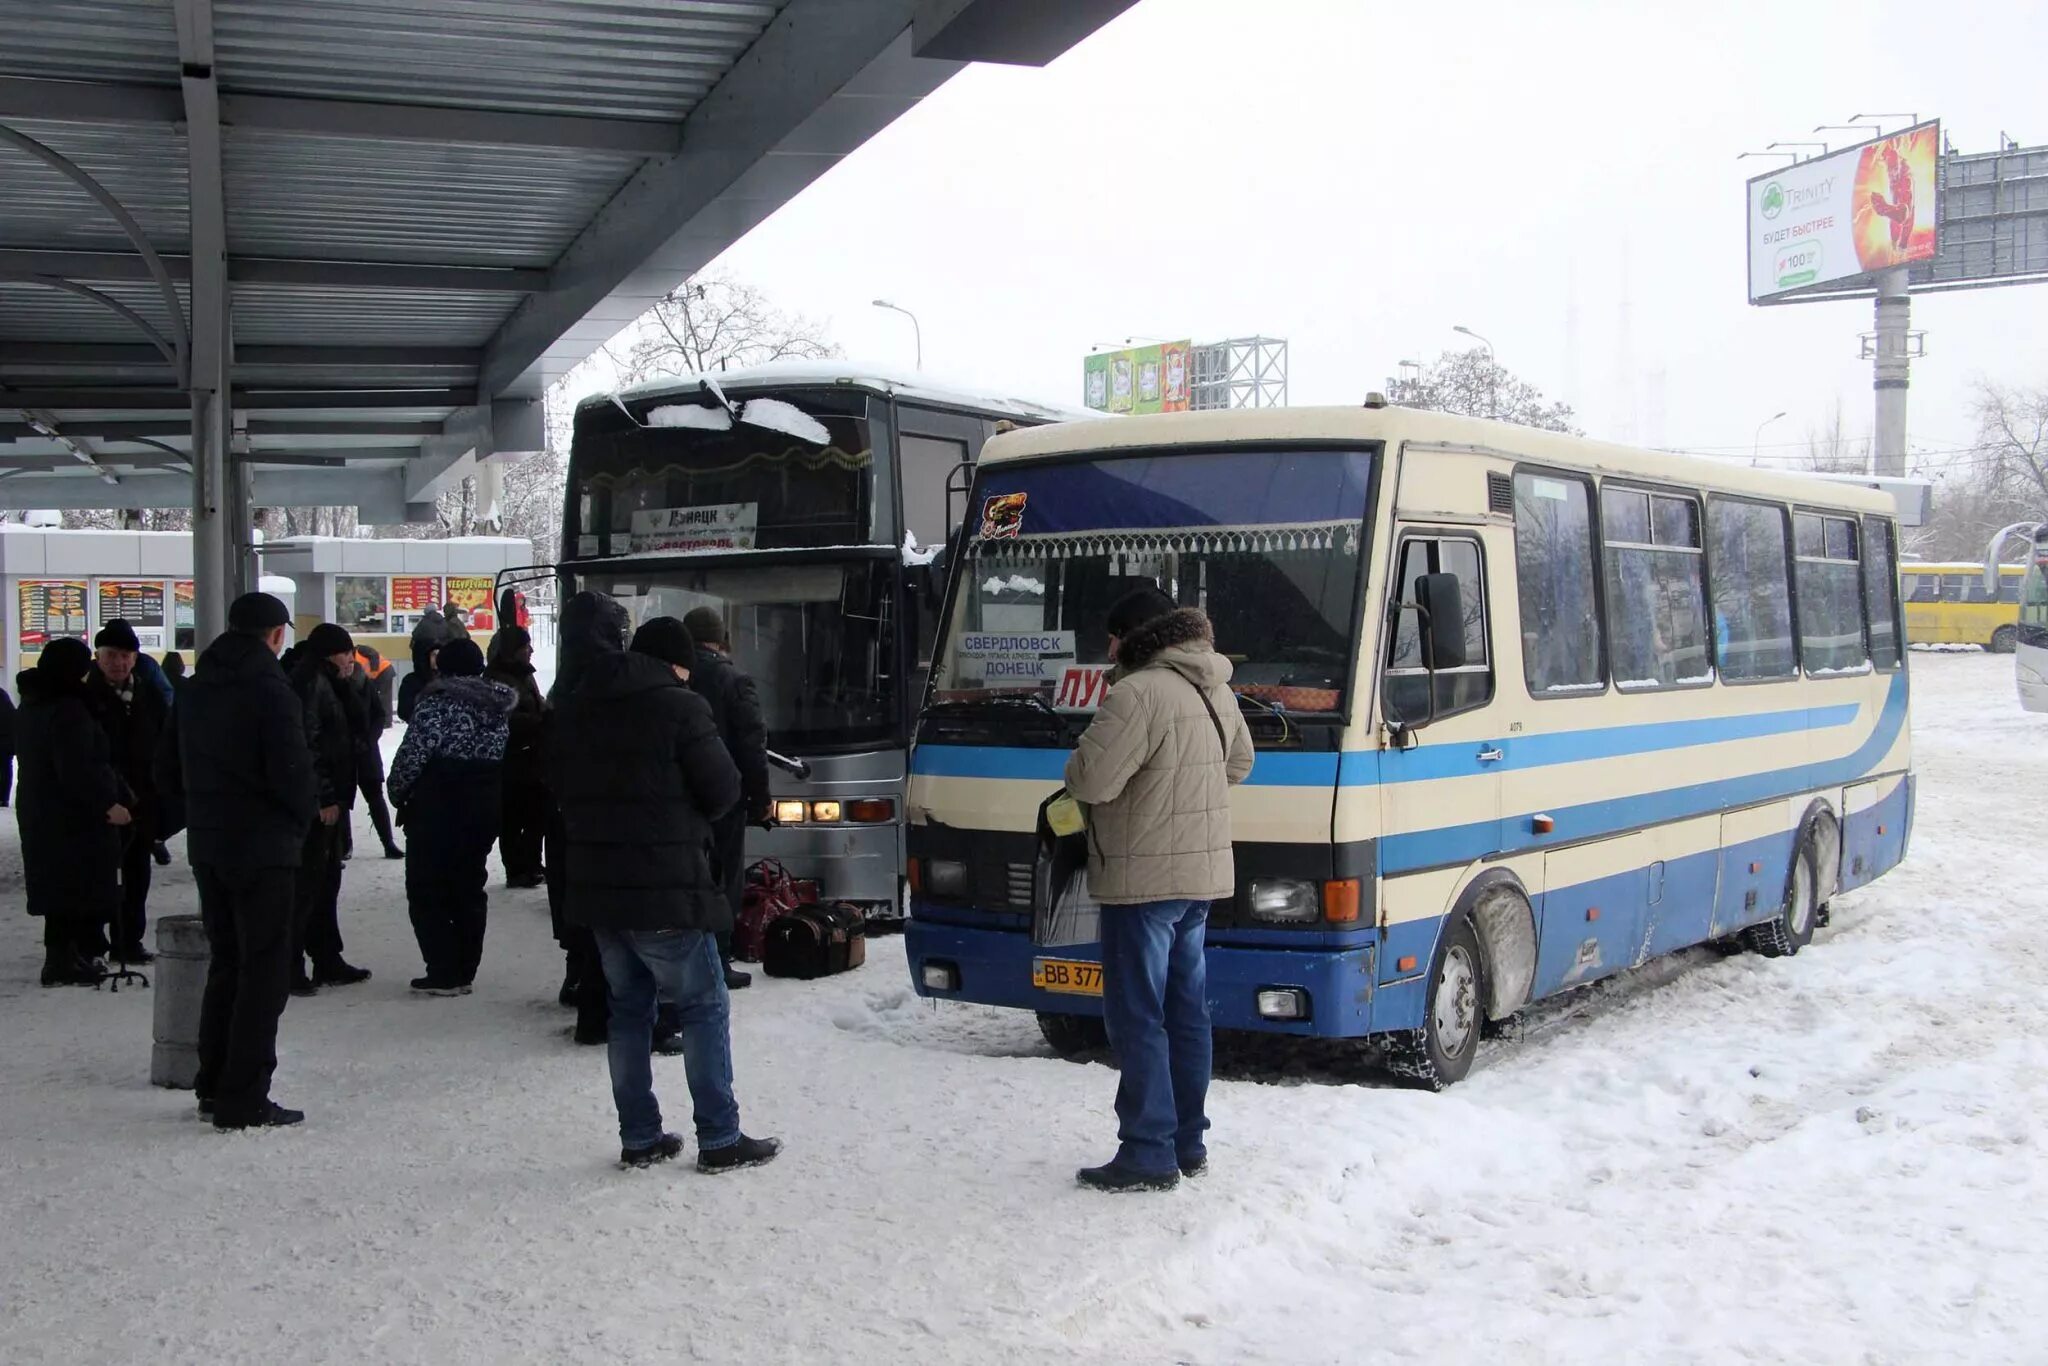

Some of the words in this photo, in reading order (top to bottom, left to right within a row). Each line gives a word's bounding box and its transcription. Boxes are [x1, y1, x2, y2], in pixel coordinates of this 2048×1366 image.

[1763, 227, 1790, 245] БУДЕТ
[1792, 216, 1834, 237] БЫСТРЕЕ
[1788, 253, 1805, 268] 100
[447, 578, 492, 590] ЧЕБУРЕЧНАЯ
[965, 636, 1061, 651] СВЕРДЛОВСК
[985, 661, 1045, 677] ДОНЕЦК
